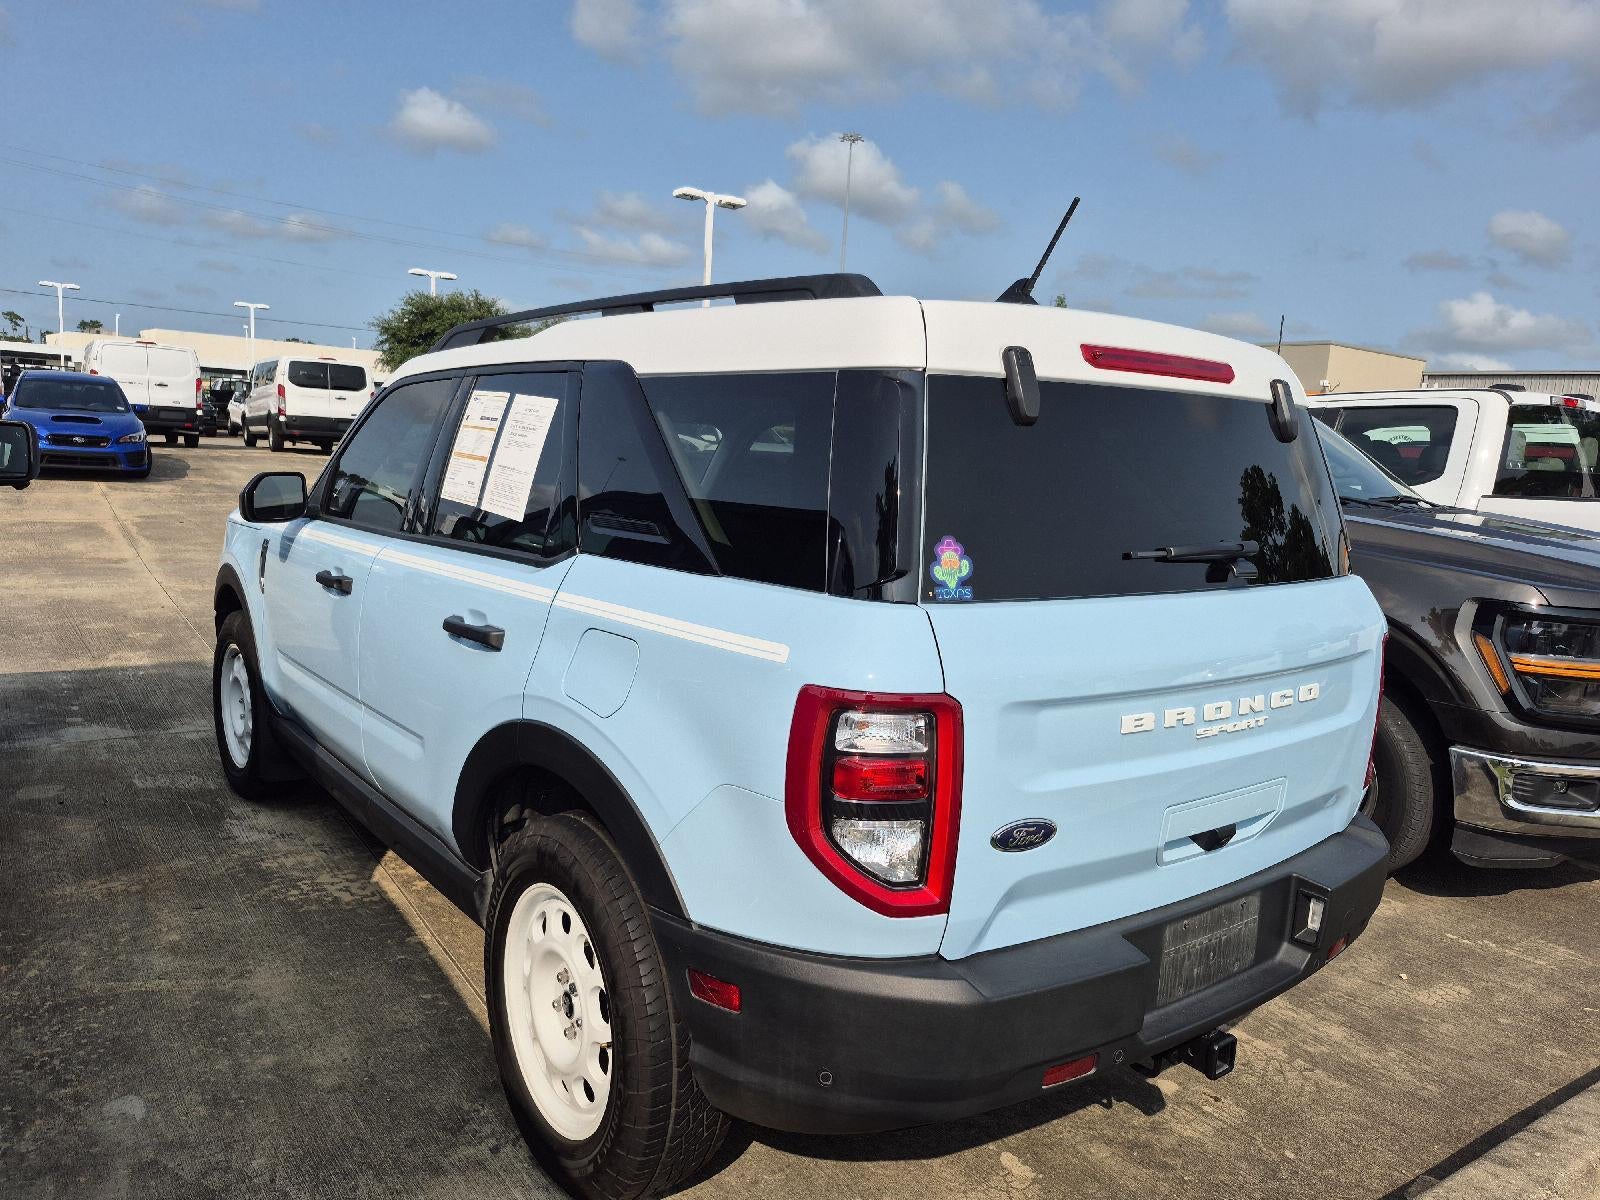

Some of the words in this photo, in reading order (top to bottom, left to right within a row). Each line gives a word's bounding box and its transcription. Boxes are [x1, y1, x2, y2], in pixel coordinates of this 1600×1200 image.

[935, 587, 972, 599] TEXAS
[1120, 682, 1320, 735] BRONCO
[1195, 715, 1268, 739] SPORT
